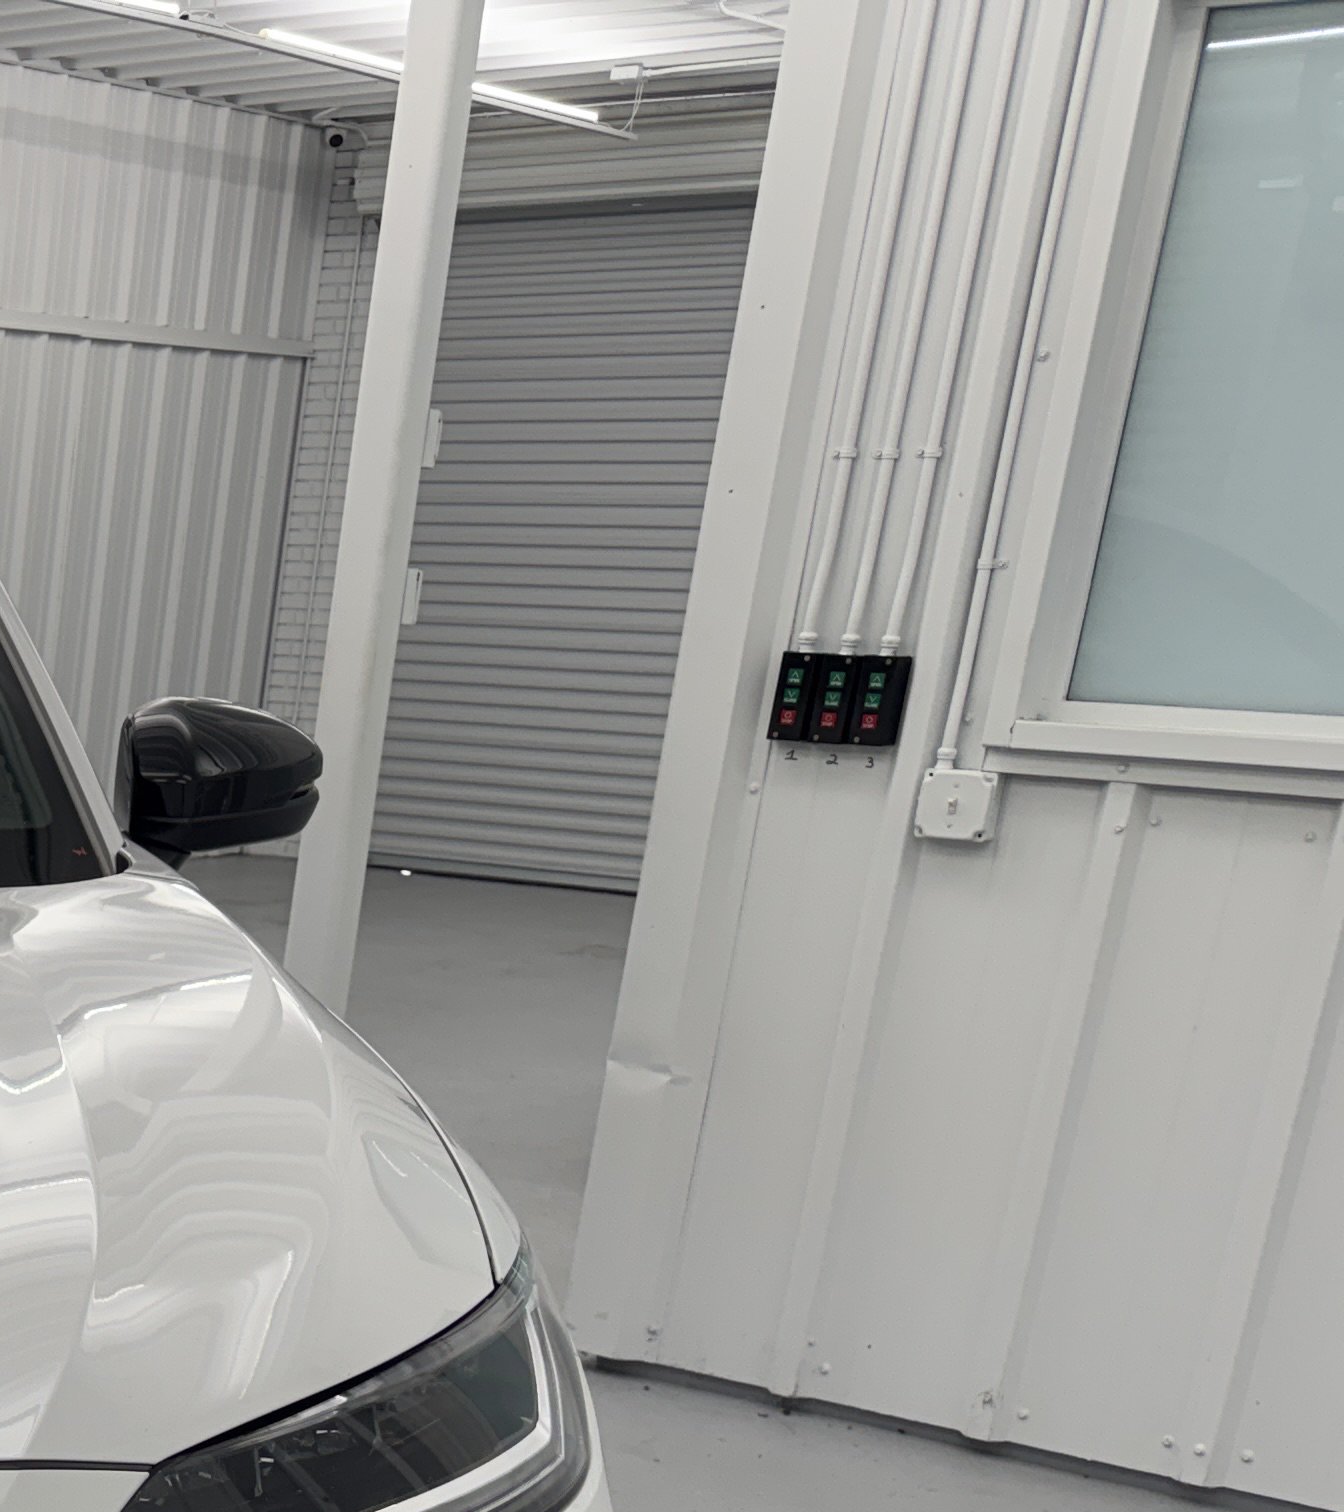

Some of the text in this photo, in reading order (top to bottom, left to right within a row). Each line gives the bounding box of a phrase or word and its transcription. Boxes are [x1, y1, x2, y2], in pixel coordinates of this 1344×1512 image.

[784, 749, 798, 761] 1
[825, 753, 839, 765] 2
[864, 756, 875, 769] 3
